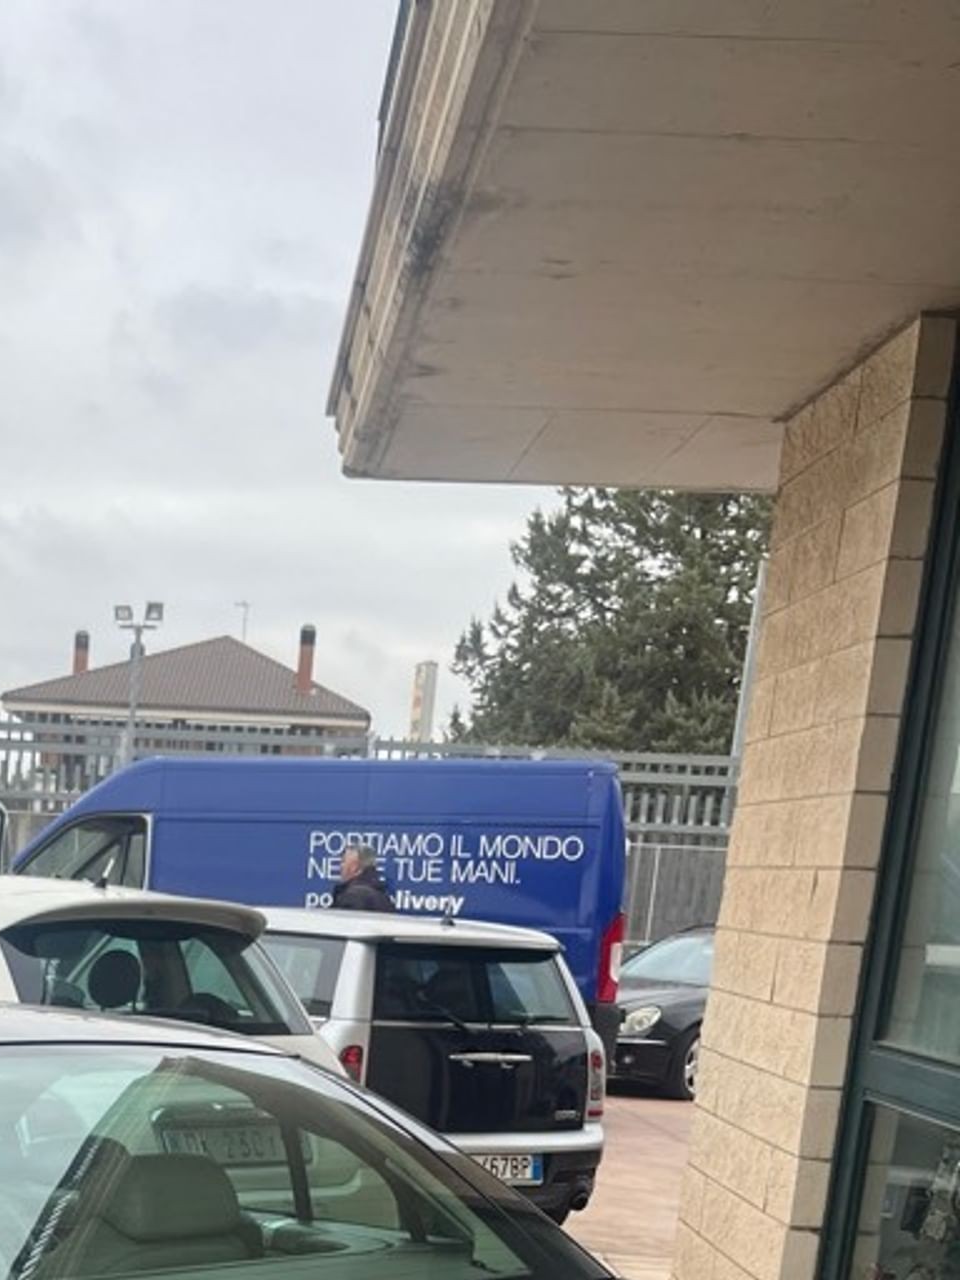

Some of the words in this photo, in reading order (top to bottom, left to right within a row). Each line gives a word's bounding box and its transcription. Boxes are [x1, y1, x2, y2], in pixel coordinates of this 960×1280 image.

[451, 834, 471, 858] IL
[480, 835, 584, 860] MONDO
[306, 857, 387, 881] NEE
[393, 858, 443, 882] TUE
[451, 860, 521, 884] MANI.
